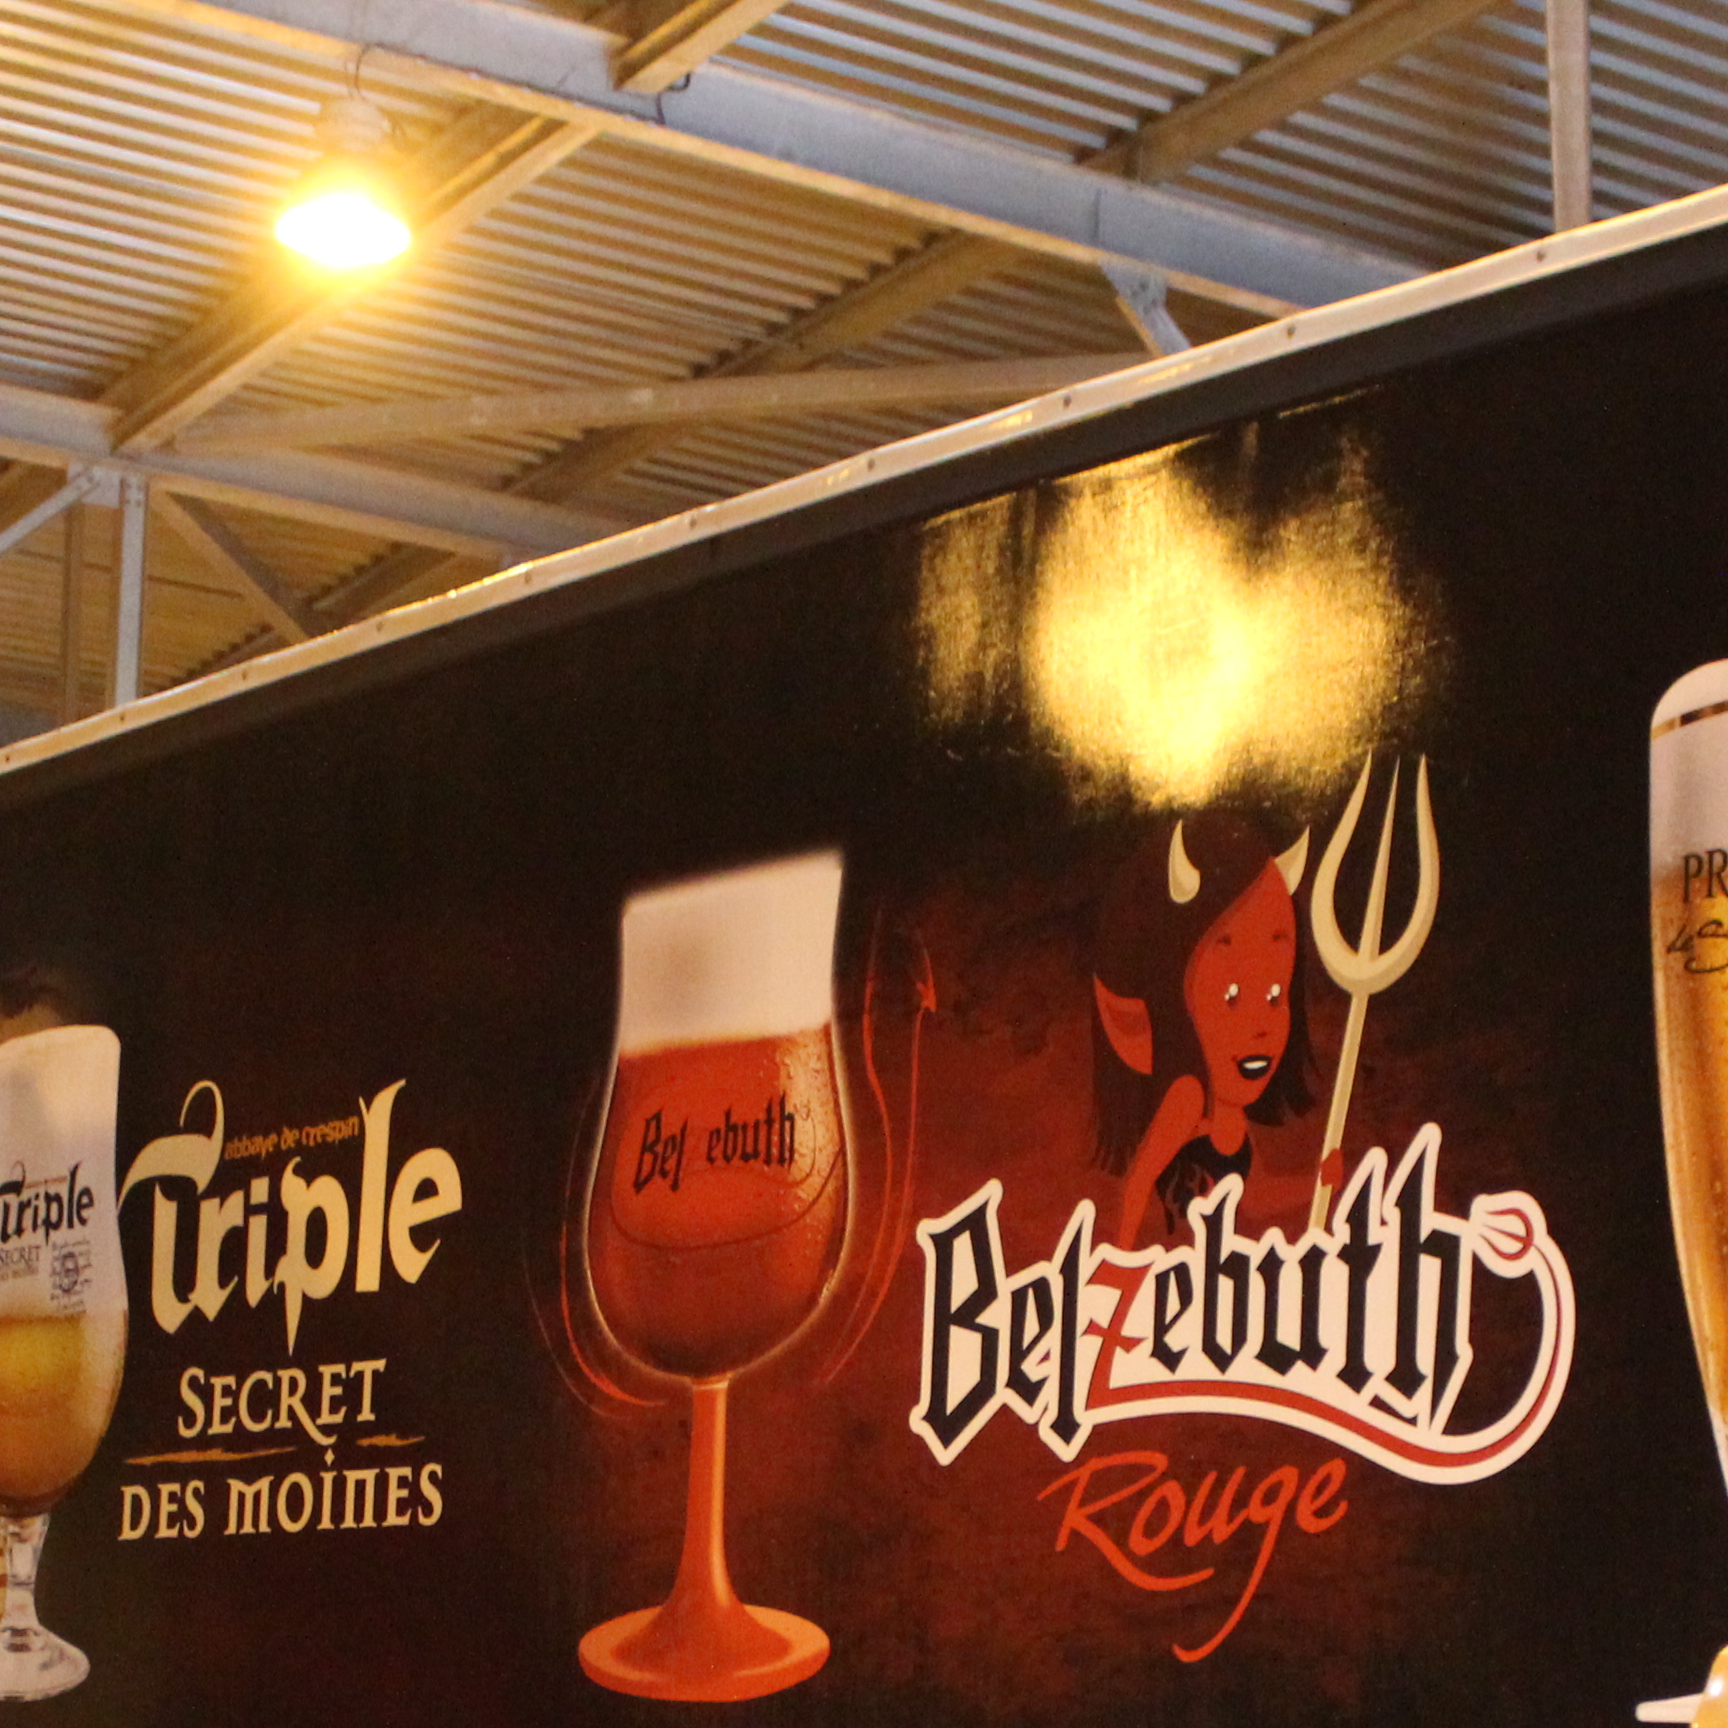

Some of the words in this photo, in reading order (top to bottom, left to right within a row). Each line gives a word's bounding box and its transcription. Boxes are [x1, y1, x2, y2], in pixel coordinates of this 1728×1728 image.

[281, 1124, 299, 1150] de
[117, 1079, 463, 1356] Triple
[909, 1122, 1484, 1468] Belzebuth
[177, 1358, 386, 1446] SECRET
[118, 1480, 205, 1541] DES
[1037, 1450, 1349, 1663] Rouge
